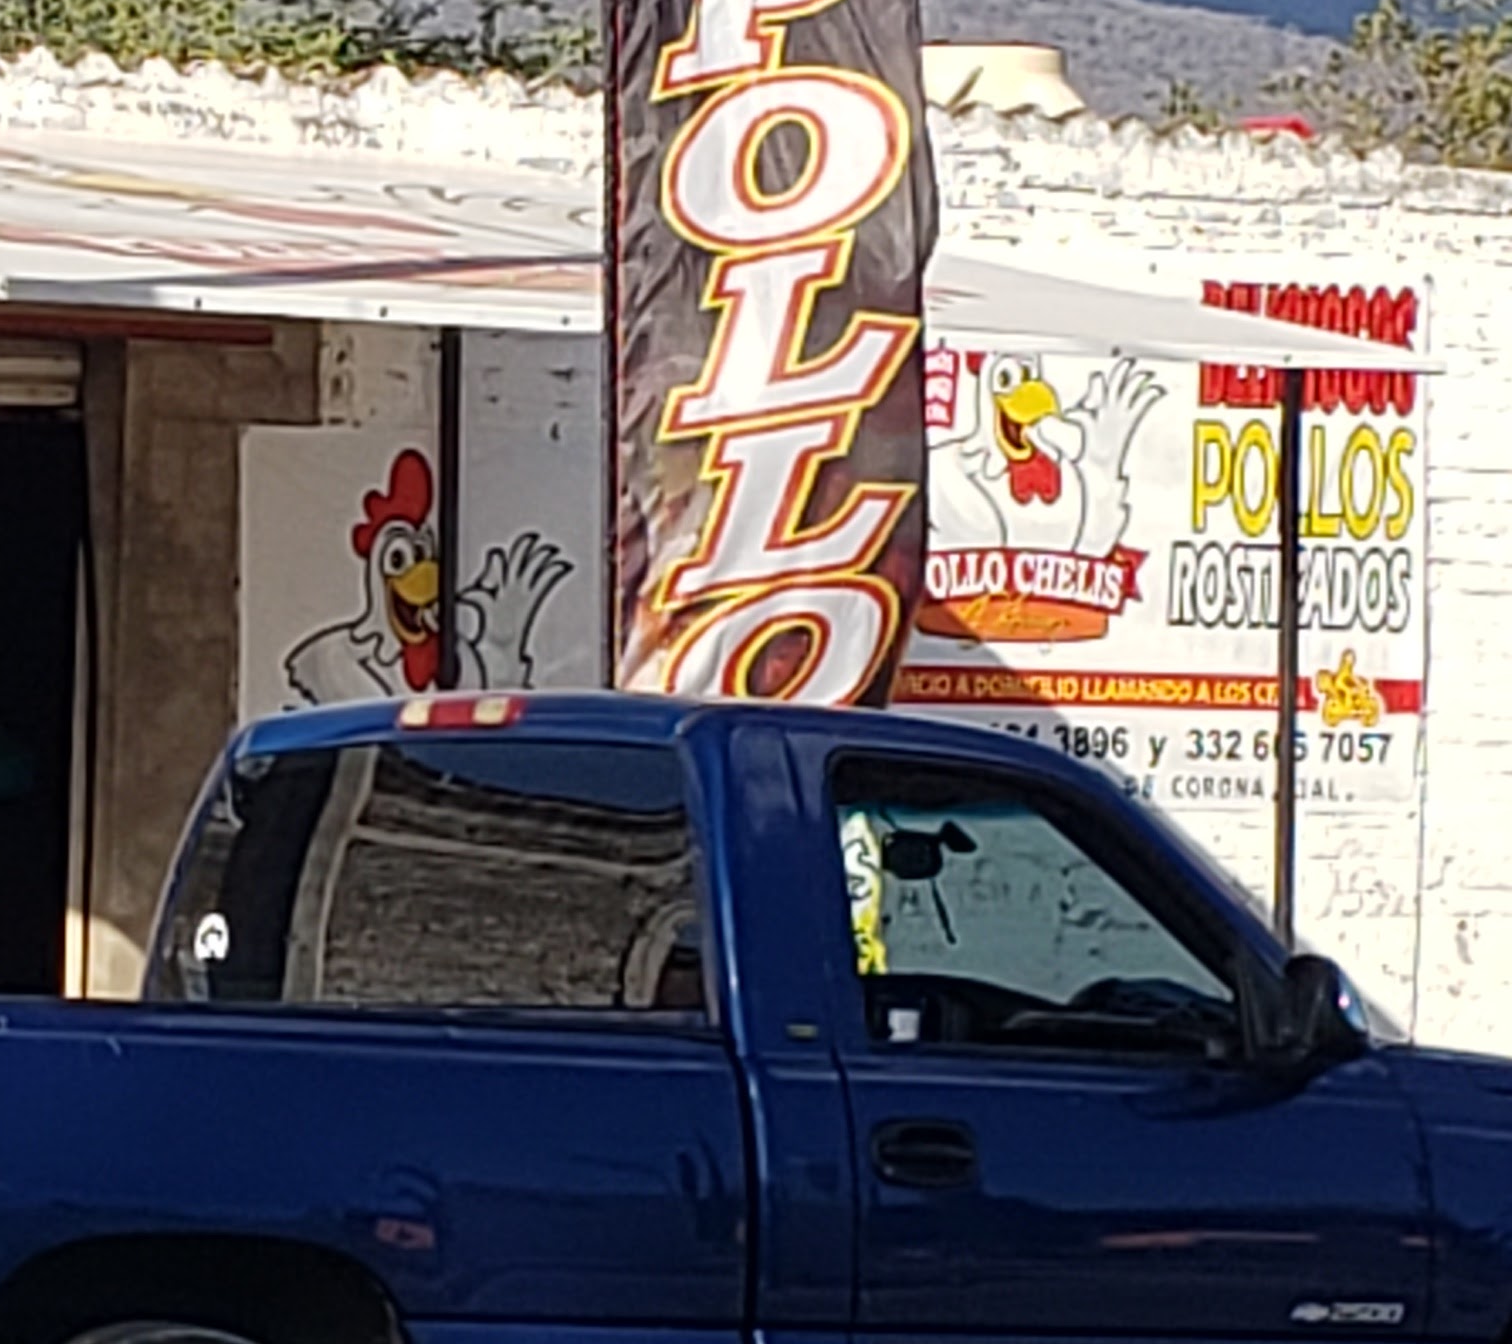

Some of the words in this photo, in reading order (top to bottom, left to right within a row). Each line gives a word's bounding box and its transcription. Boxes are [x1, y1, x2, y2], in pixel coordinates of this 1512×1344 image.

[1193, 419, 1417, 541] POLOS
[926, 550, 1007, 600] OLLO
[1013, 553, 1124, 608] CHELIS
[1167, 541, 1413, 633] ROSTIADOS
[1196, 681, 1211, 704] A
[1213, 681, 1251, 706] LOS
[1054, 725, 1130, 759] 3896
[1149, 735, 1166, 767] y
[1186, 728, 1242, 762] 332
[1319, 732, 1393, 764] 7057
